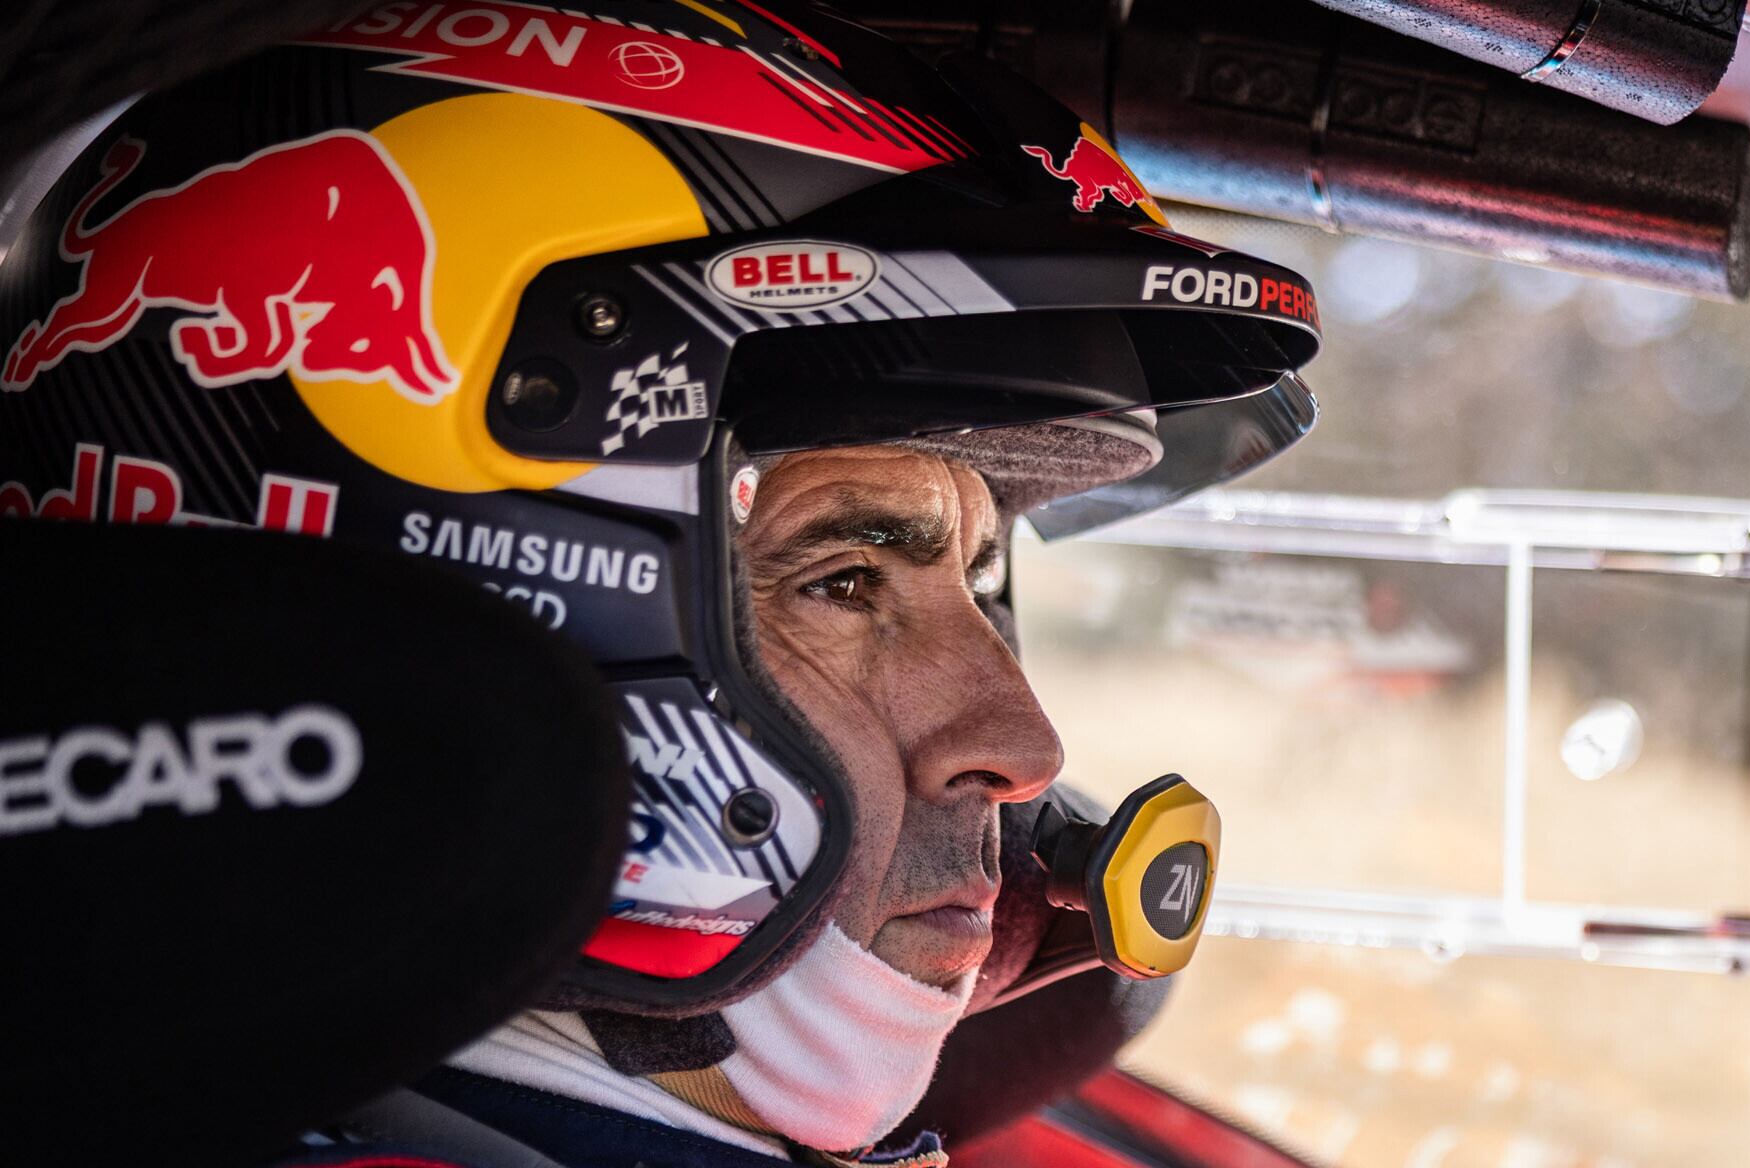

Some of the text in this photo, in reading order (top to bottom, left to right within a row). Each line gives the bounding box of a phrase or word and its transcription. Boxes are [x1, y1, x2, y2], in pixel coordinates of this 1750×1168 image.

[732, 252, 853, 288] BELL
[750, 286, 840, 299] HELMETS
[400, 511, 661, 595] SAMSUNG
